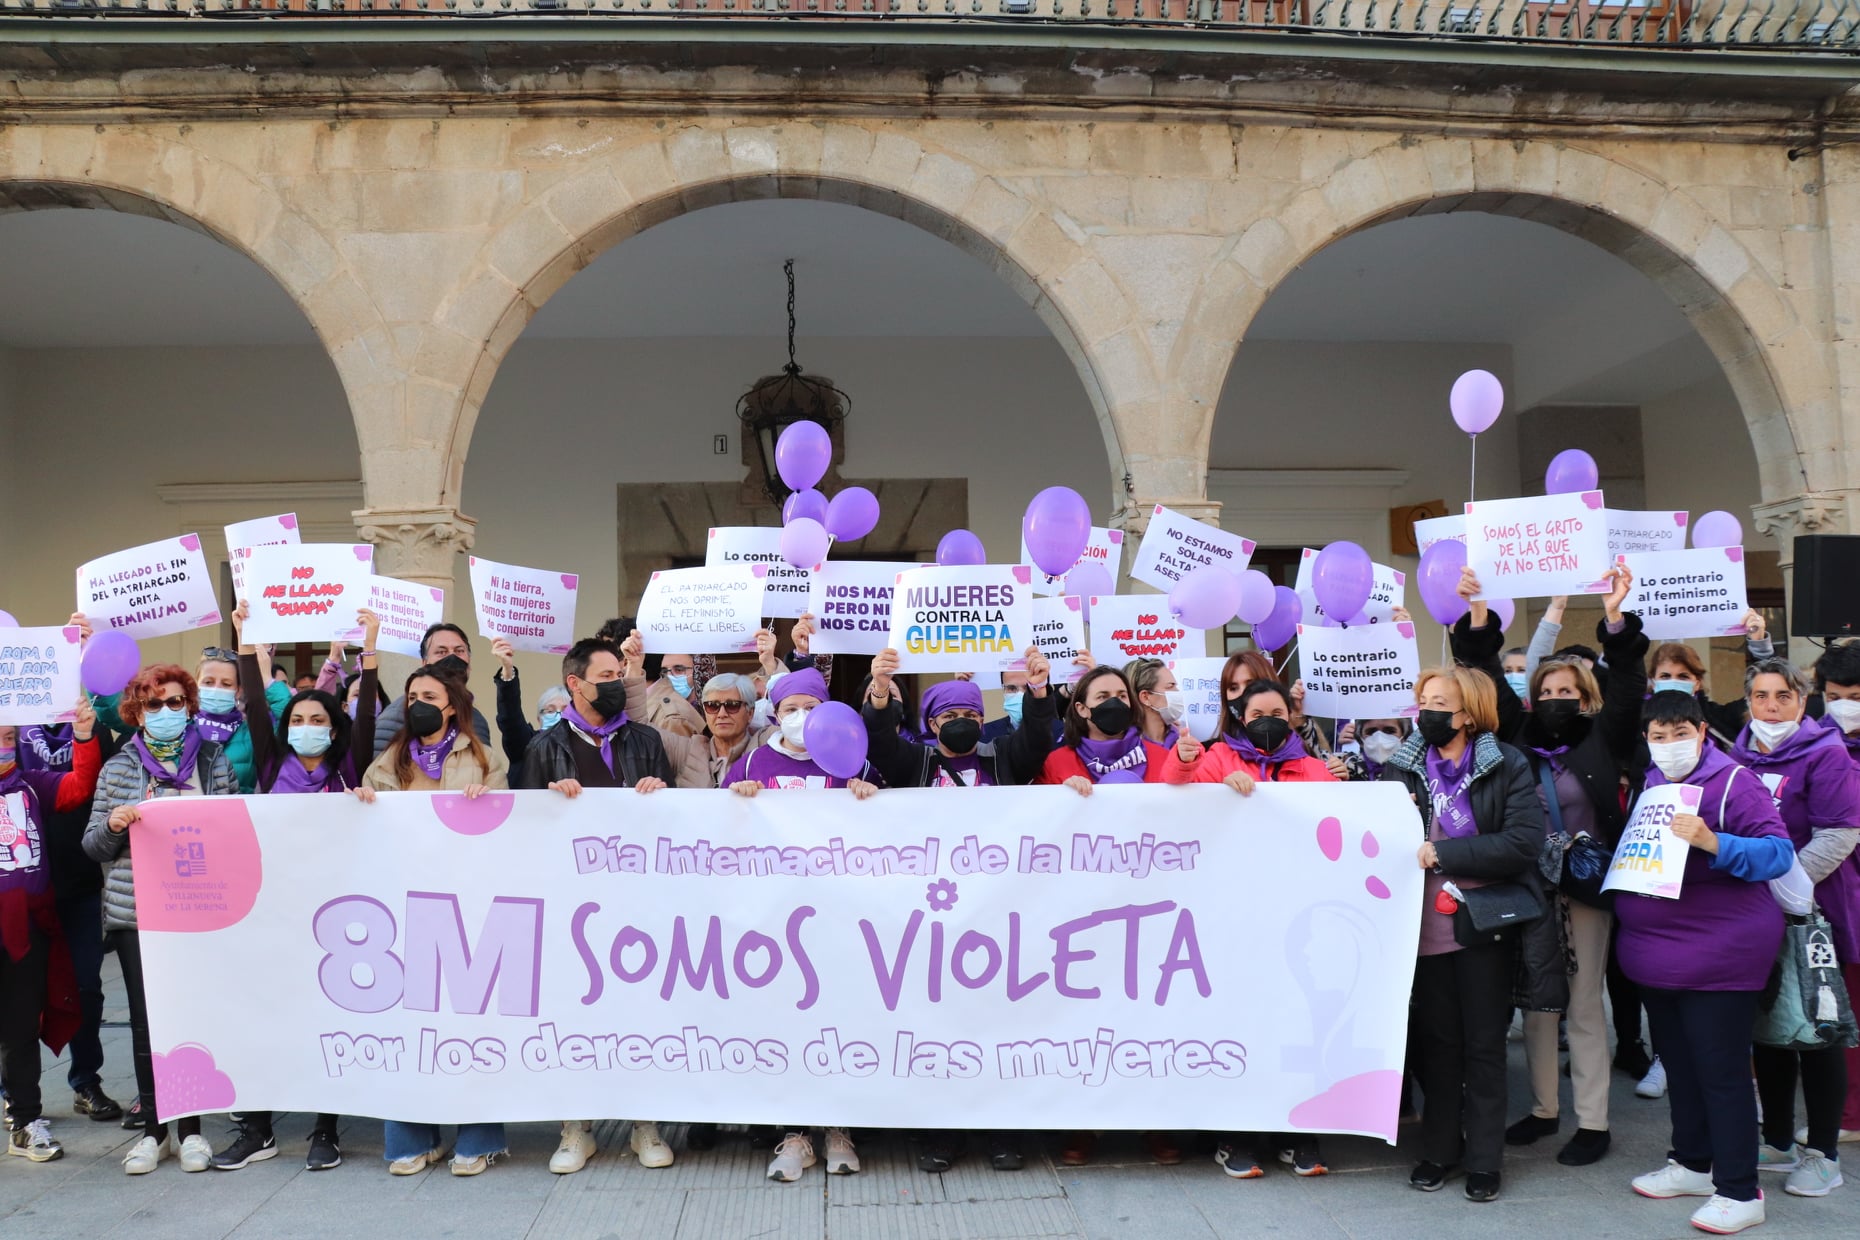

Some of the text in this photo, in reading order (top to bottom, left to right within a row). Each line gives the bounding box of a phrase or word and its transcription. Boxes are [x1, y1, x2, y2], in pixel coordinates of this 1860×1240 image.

[1483, 517, 1583, 542] SOMOS EL GRITO
[1608, 528, 1673, 539] PATRIARCADO
[1166, 527, 1234, 560] NO ESTAMOS
[1498, 538, 1571, 557] DE LAS QUE
[1608, 541, 1620, 550] OS
[724, 551, 786, 562] Lo contr
[1159, 552, 1196, 572] FALTA
[1176, 546, 1213, 566] SOLAS
[89, 558, 187, 589] HA LLEGADO EL FIN
[291, 565, 315, 580] NO
[767, 566, 809, 578] nismo
[1153, 563, 1181, 582] ASES
[1494, 560, 1511, 576] YA
[1516, 558, 1534, 575] NO
[92, 571, 191, 602] DEL PATRIARCADO,
[490, 575, 545, 597] Ni la tierra,
[1640, 571, 1724, 587] Lo contrario
[263, 582, 344, 599] ME LLAMO
[382, 587, 391, 599] la
[660, 582, 748, 594] EL PATRIARCADO
[826, 585, 895, 600] NOS MAT
[1638, 587, 1728, 602] al feminismo
[129, 593, 161, 607] GRITA
[493, 591, 507, 604] las
[510, 596, 551, 611] mujeres
[669, 595, 689, 605] NOS
[906, 584, 1015, 608] MUJERES
[110, 601, 188, 628] FEMINISMO
[391, 603, 425, 618] mujeres
[481, 603, 555, 625] somos territorio
[661, 608, 736, 618] EL FEMINISMO
[824, 601, 869, 615] PERO
[873, 603, 890, 616] NI
[1648, 605, 1660, 616] la
[1664, 600, 1739, 617] ignorancia
[915, 609, 1005, 624] CONTRA LA
[1137, 613, 1159, 625] NO
[496, 623, 545, 637] conquista
[650, 621, 746, 633] NOS HACE LIBRES
[820, 618, 891, 632] NOS CAL
[1032, 619, 1064, 632] rario
[905, 624, 1015, 655] GUERRA
[1111, 629, 1134, 641] ME
[45, 646, 55, 660] O
[1313, 648, 1397, 663] Lo contrario
[20, 661, 59, 676] ROPA
[1312, 665, 1402, 678] al feminismo
[1306, 681, 1319, 691] es
[1322, 681, 1333, 693] la
[16, 692, 53, 707] TOCA
[572, 832, 1201, 879] Día Internacional de la Mujer
[312, 890, 545, 1018] 8M
[571, 901, 820, 1011] SOMOS
[319, 1021, 1248, 1088] por los derechos de las mujeres
